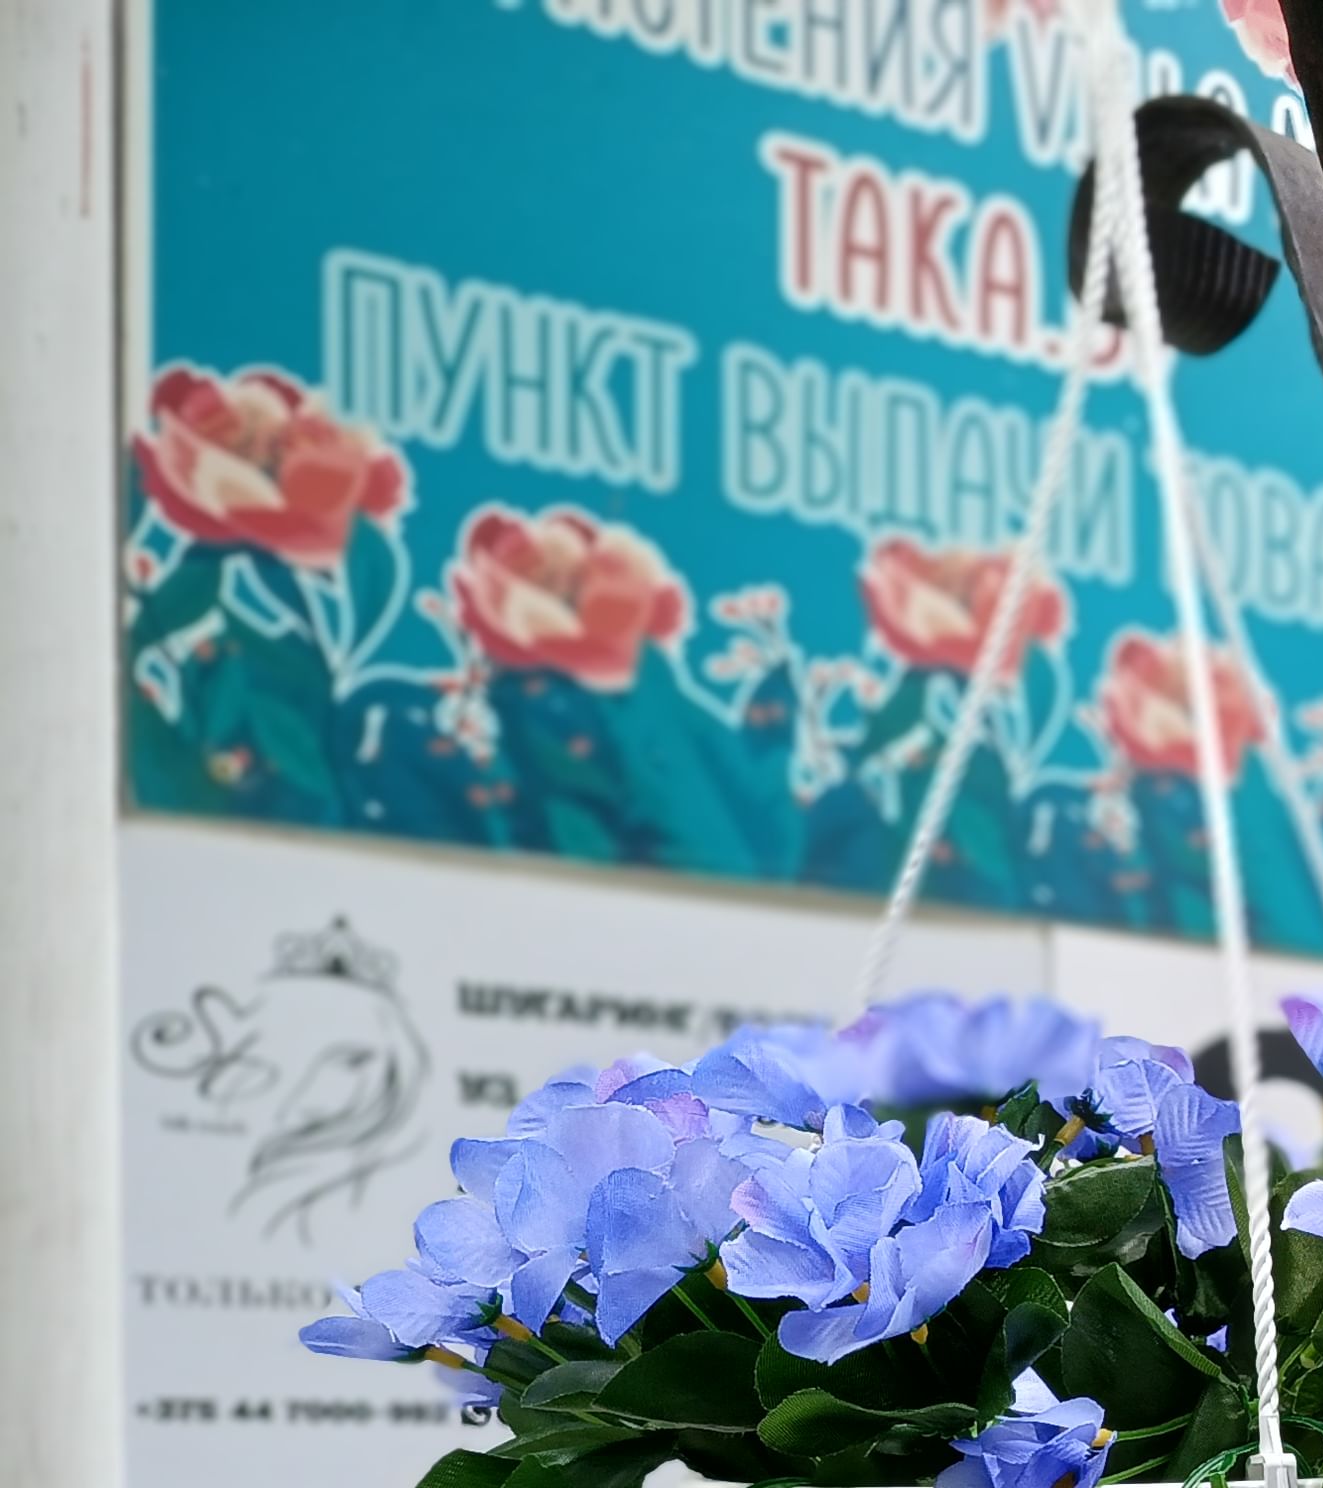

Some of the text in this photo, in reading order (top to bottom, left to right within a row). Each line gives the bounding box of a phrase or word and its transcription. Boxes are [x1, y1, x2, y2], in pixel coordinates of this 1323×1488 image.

[324, 250, 696, 492] ПУНКТ
[722, 344, 1135, 586] ВЫДАЧИ
[231, 1399, 273, 1423] 44
